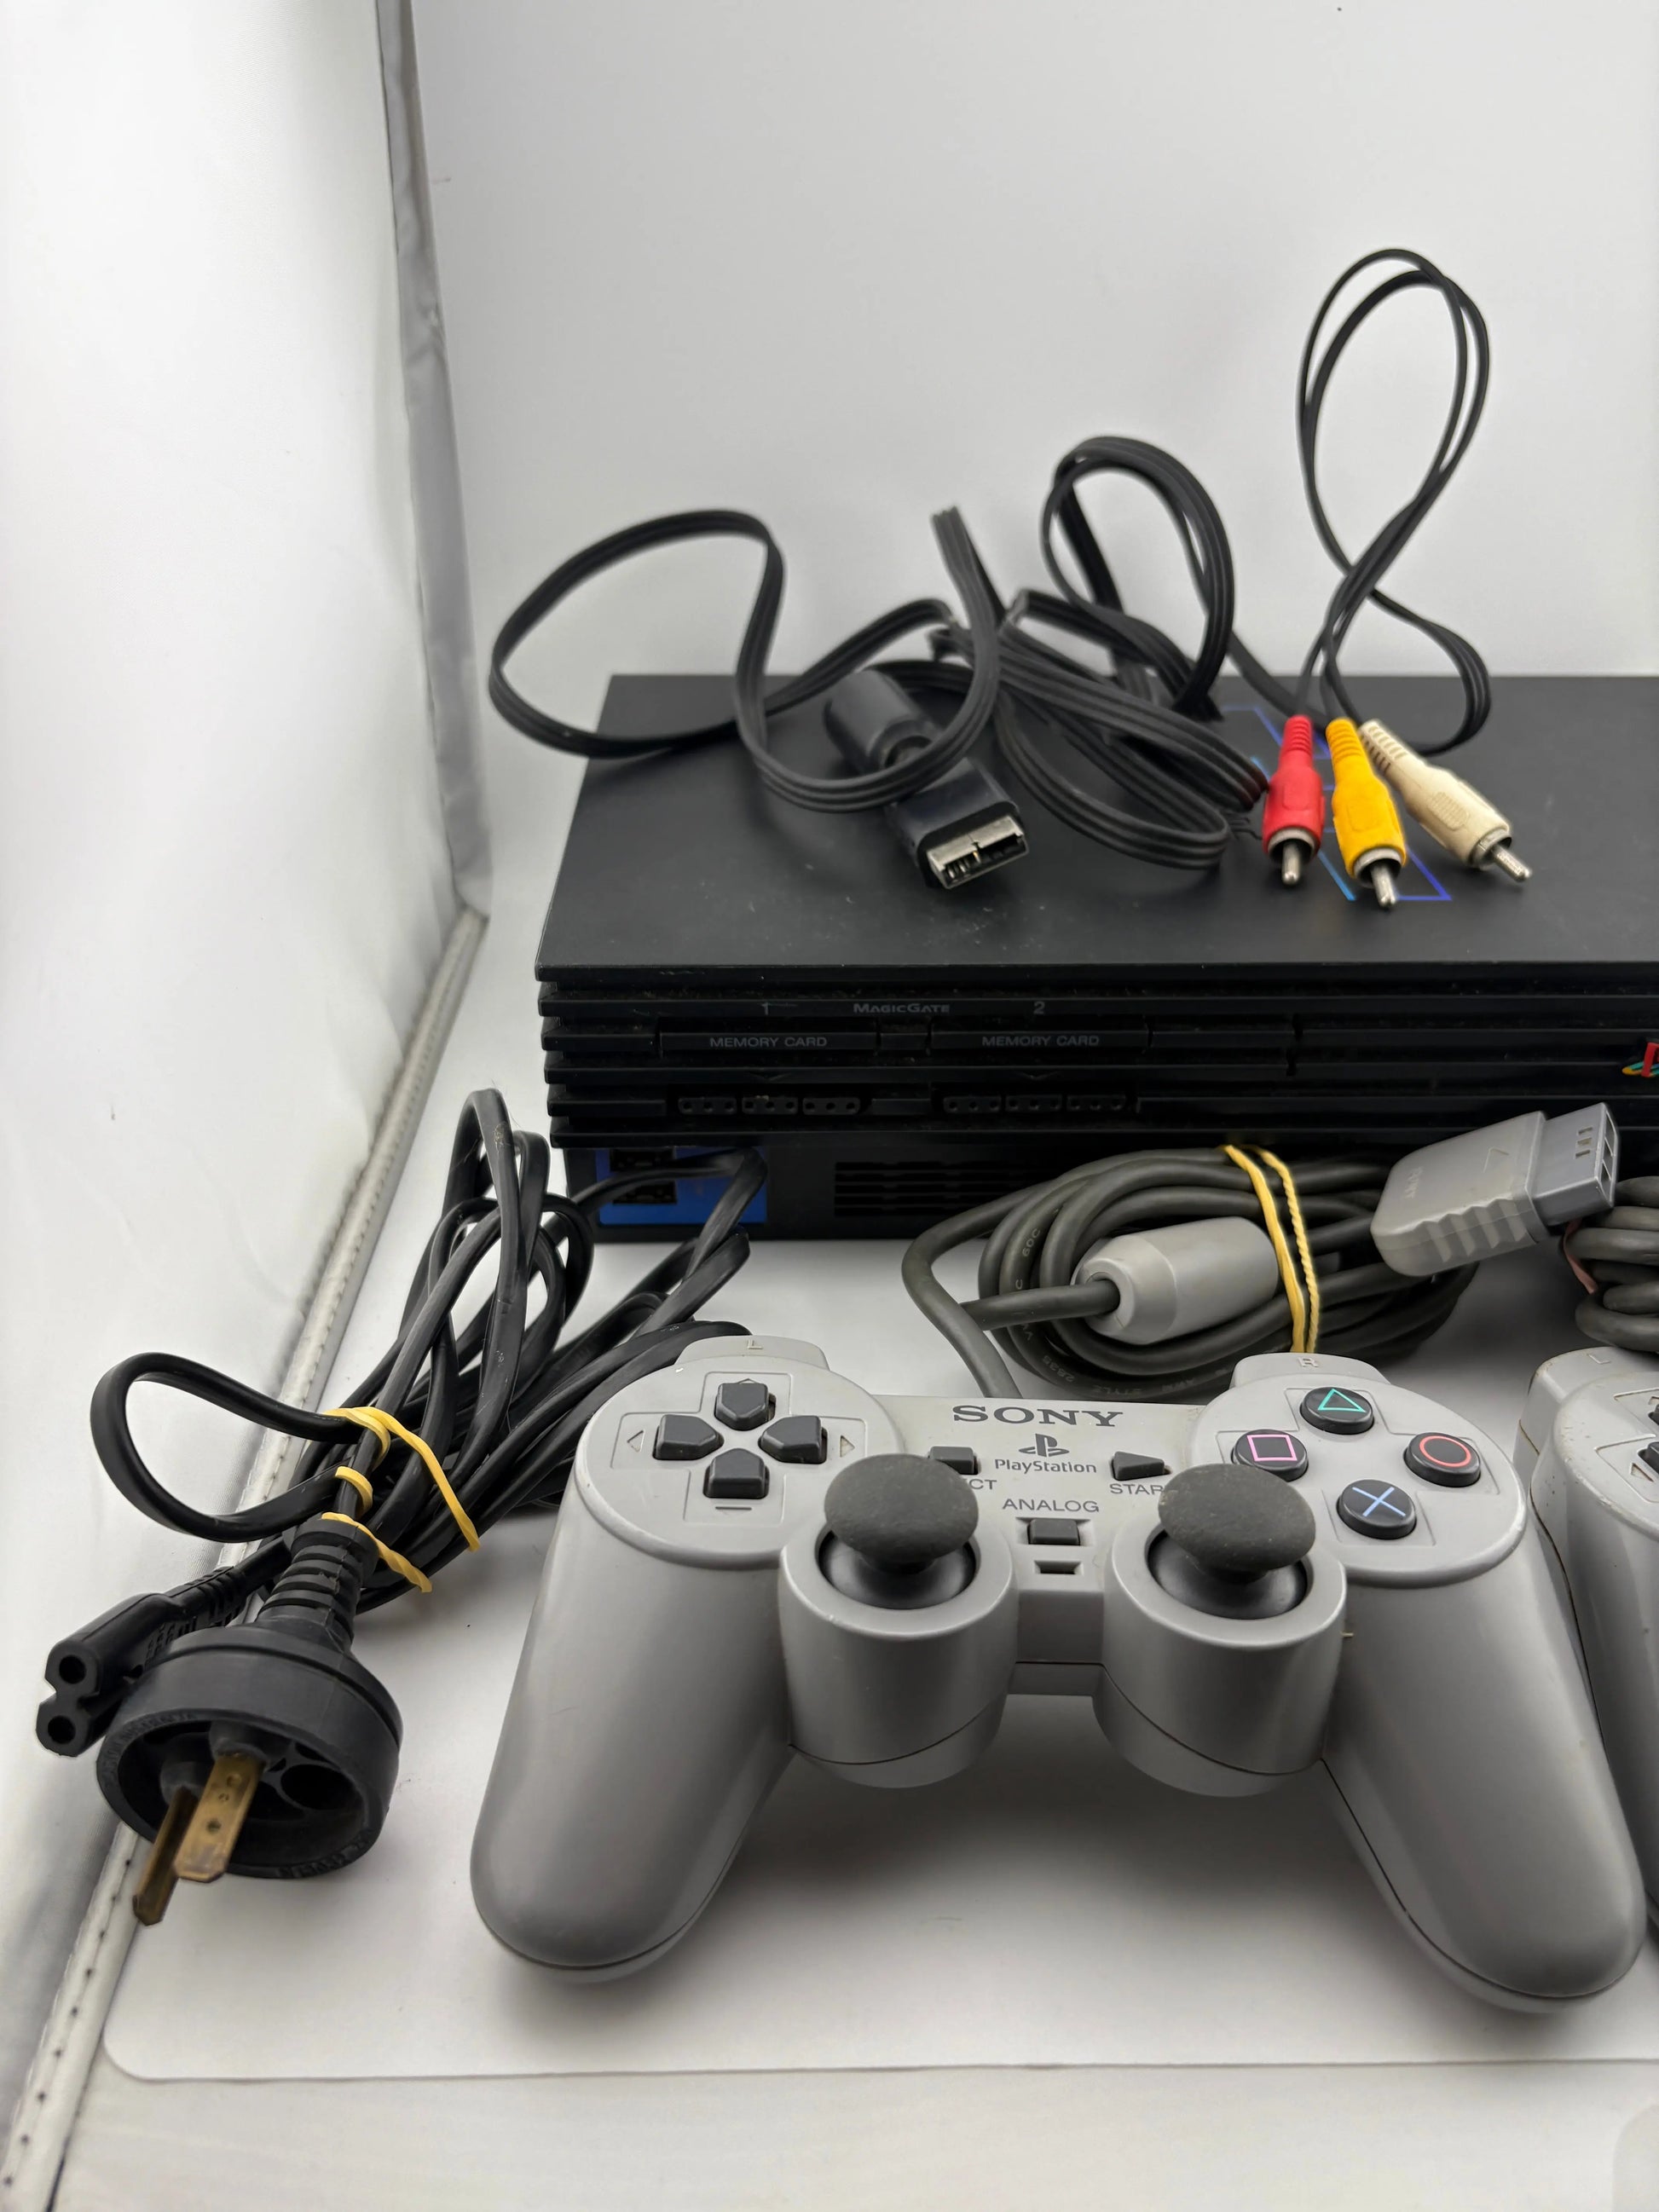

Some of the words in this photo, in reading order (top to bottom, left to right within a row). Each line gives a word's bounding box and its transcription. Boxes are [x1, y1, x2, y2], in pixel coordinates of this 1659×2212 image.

[1032, 1001, 1045, 1014] 2
[709, 1037, 781, 1048] MEMORY
[784, 1036, 828, 1048] CARD
[981, 1036, 1053, 1048] MEMORY
[1056, 1035, 1100, 1047] CARD
[952, 1405, 1123, 1427] SONY
[994, 1458, 1097, 1475] PlayStation
[1110, 1483, 1164, 1496] STAR
[1003, 1499, 1100, 1513] ANALOG
